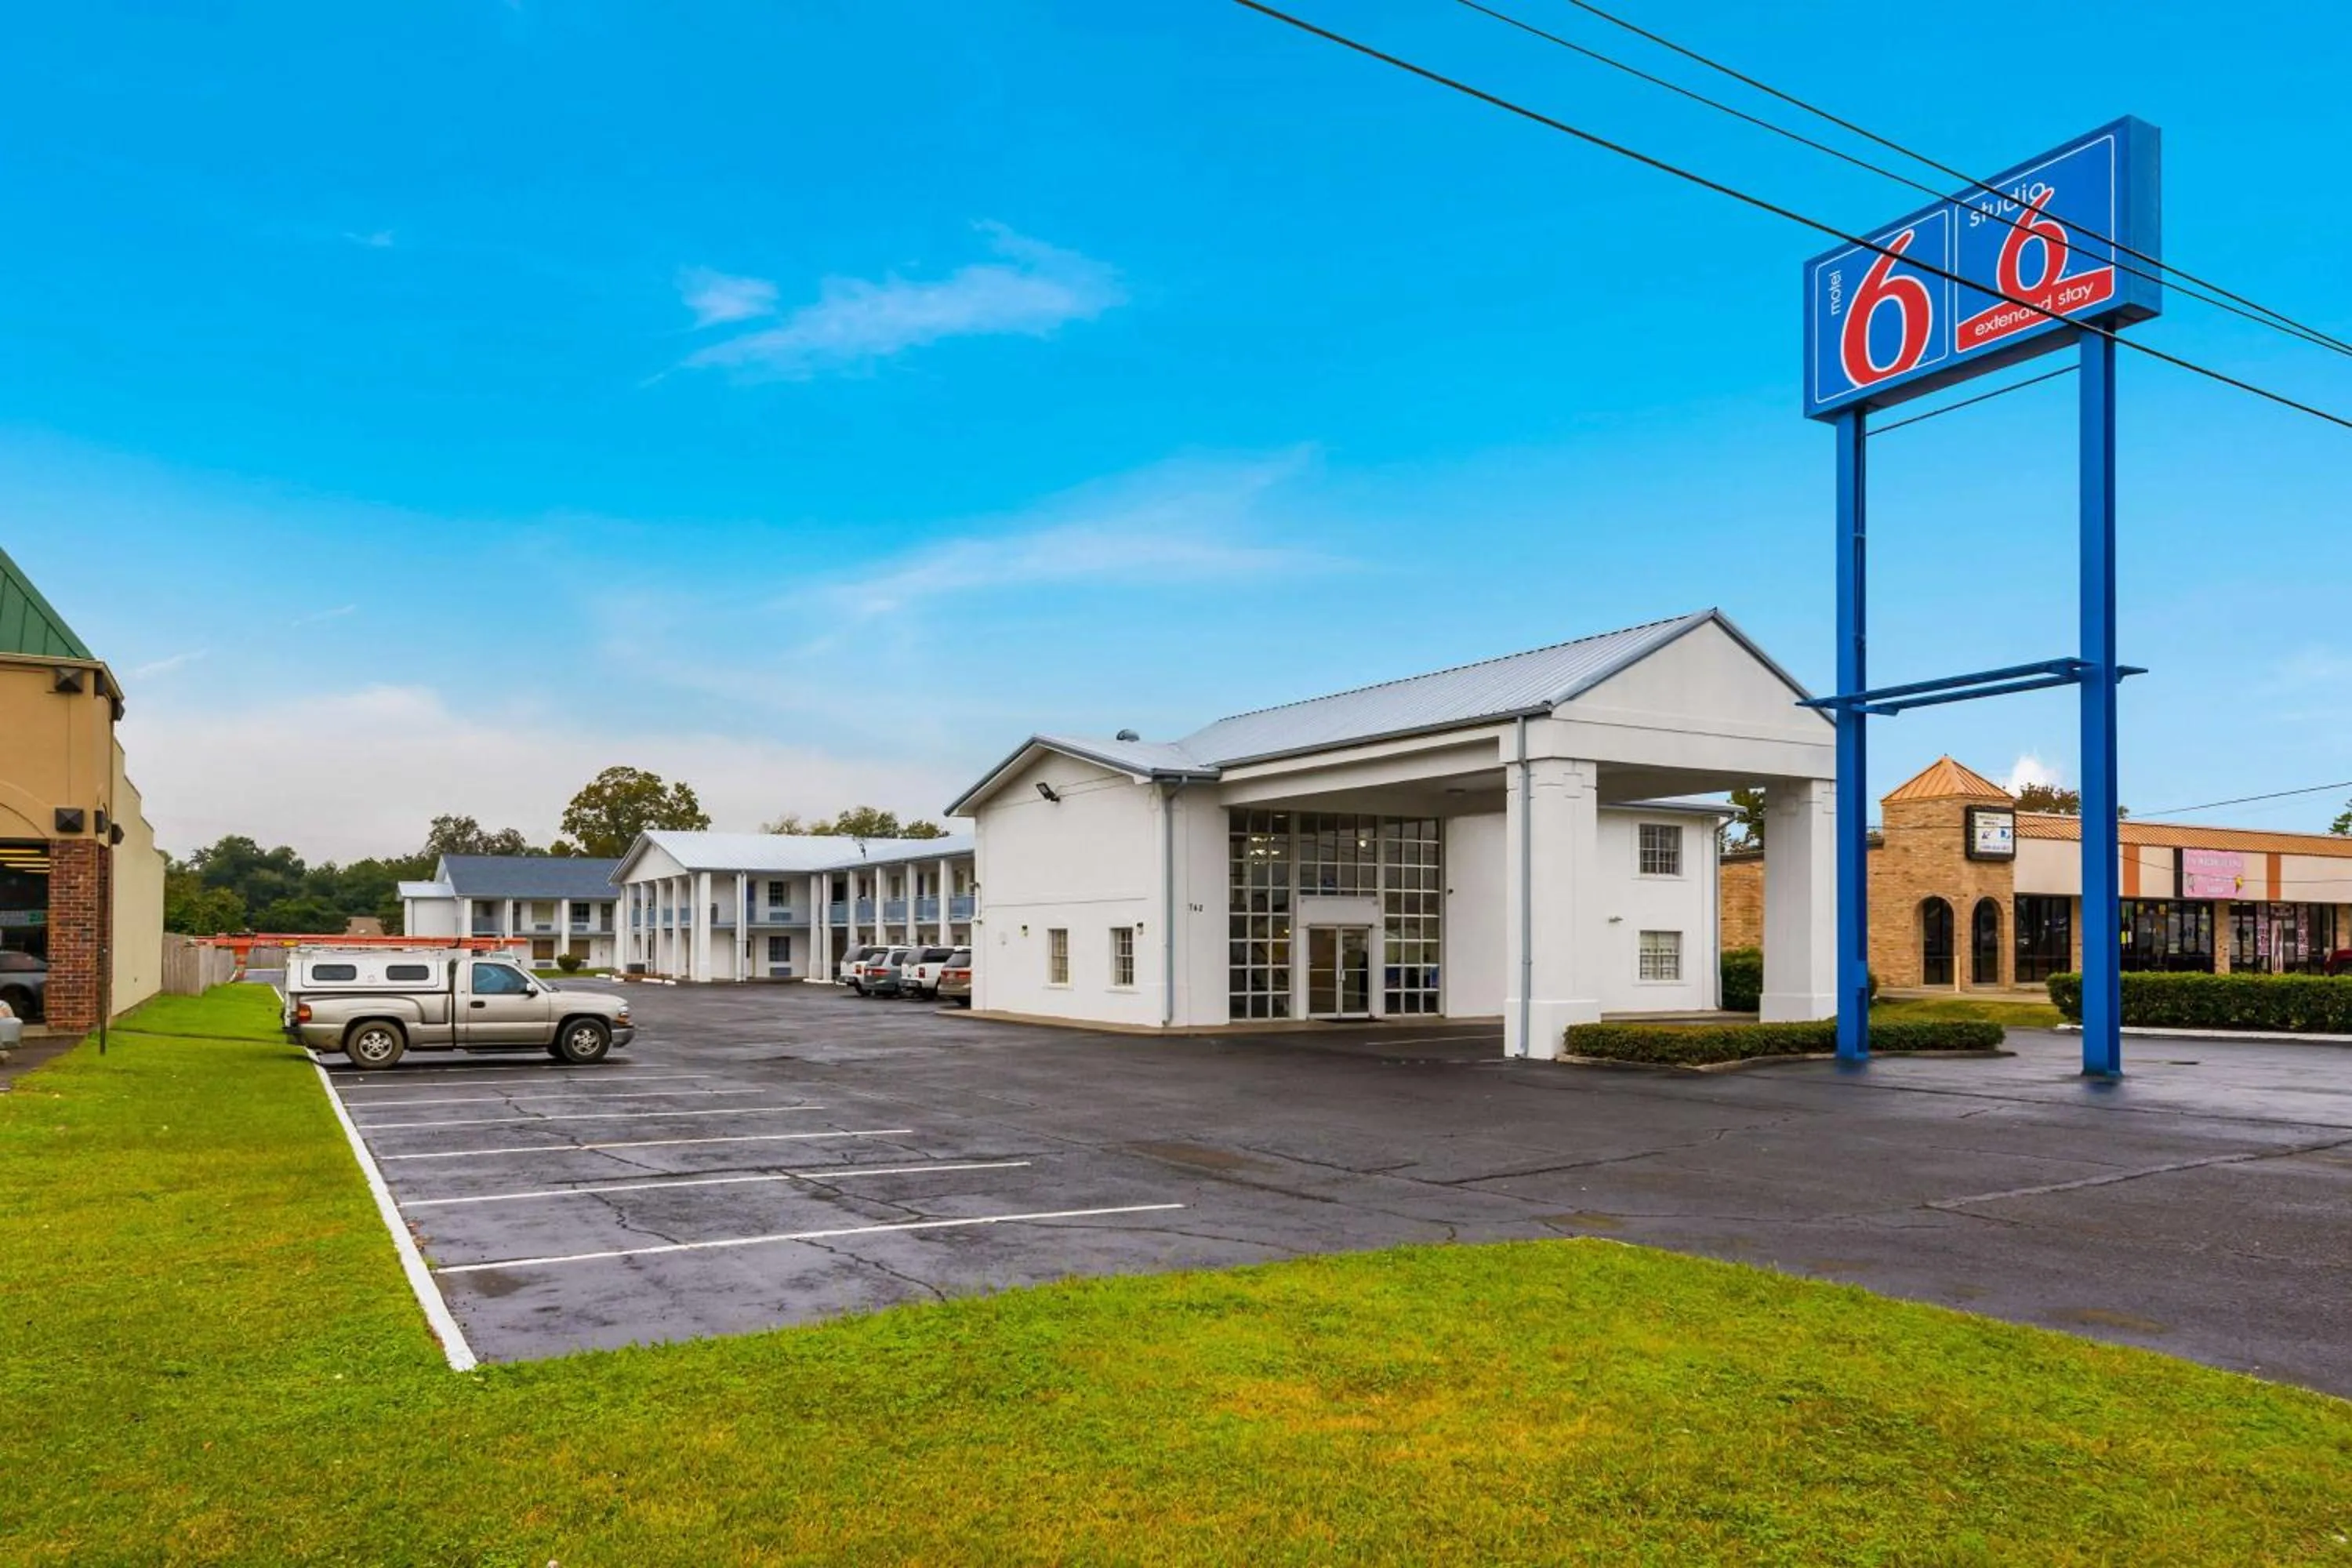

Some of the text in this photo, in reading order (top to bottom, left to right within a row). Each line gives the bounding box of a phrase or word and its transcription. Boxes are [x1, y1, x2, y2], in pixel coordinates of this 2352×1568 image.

[1969, 183, 2045, 227] studio
[1997, 187, 2068, 302] 6
[1828, 270, 1842, 315] motel
[1841, 228, 1933, 388] 6
[2058, 281, 2094, 306] stay
